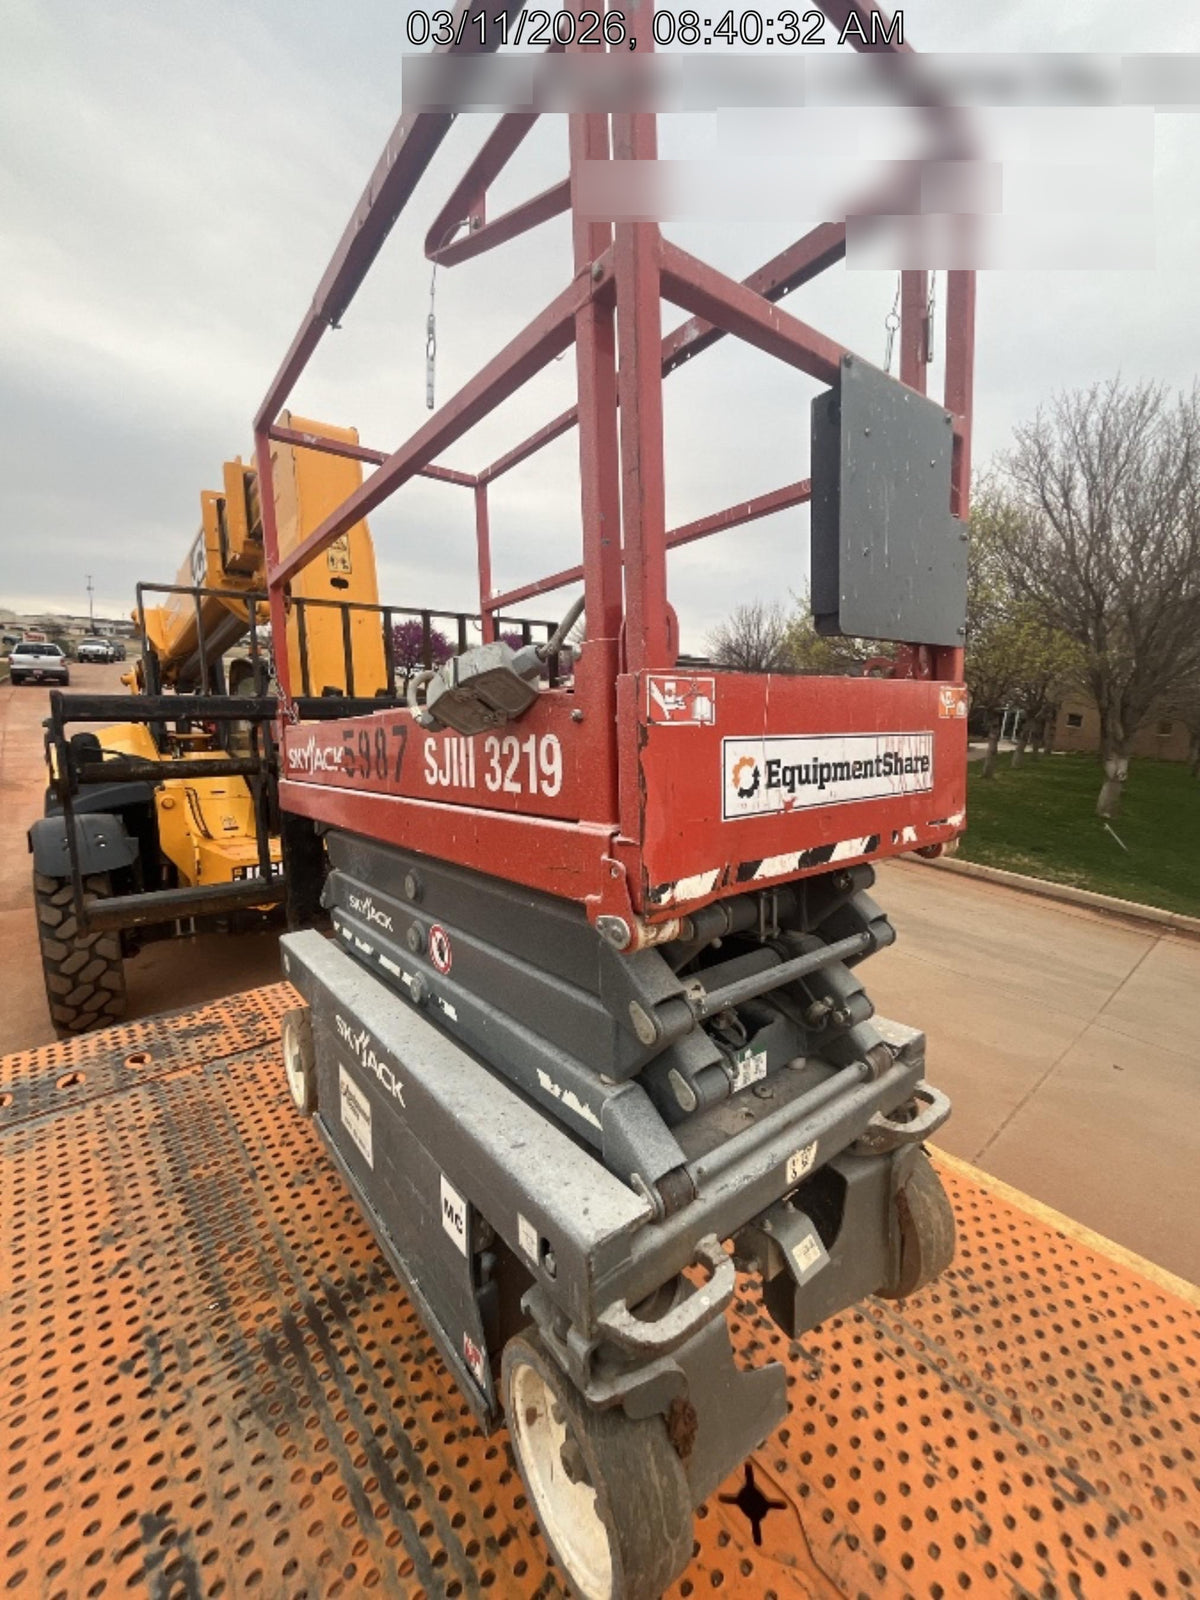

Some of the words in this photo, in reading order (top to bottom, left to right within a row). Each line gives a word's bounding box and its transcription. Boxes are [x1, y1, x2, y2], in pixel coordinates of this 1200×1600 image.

[288, 735, 346, 776] SKYJACK
[342, 724, 408, 784] 5987
[484, 733, 563, 798] 3219
[765, 751, 930, 794] EquipmentShare
[348, 894, 394, 933] SKYJACK
[335, 1014, 406, 1109] SKYJACK
